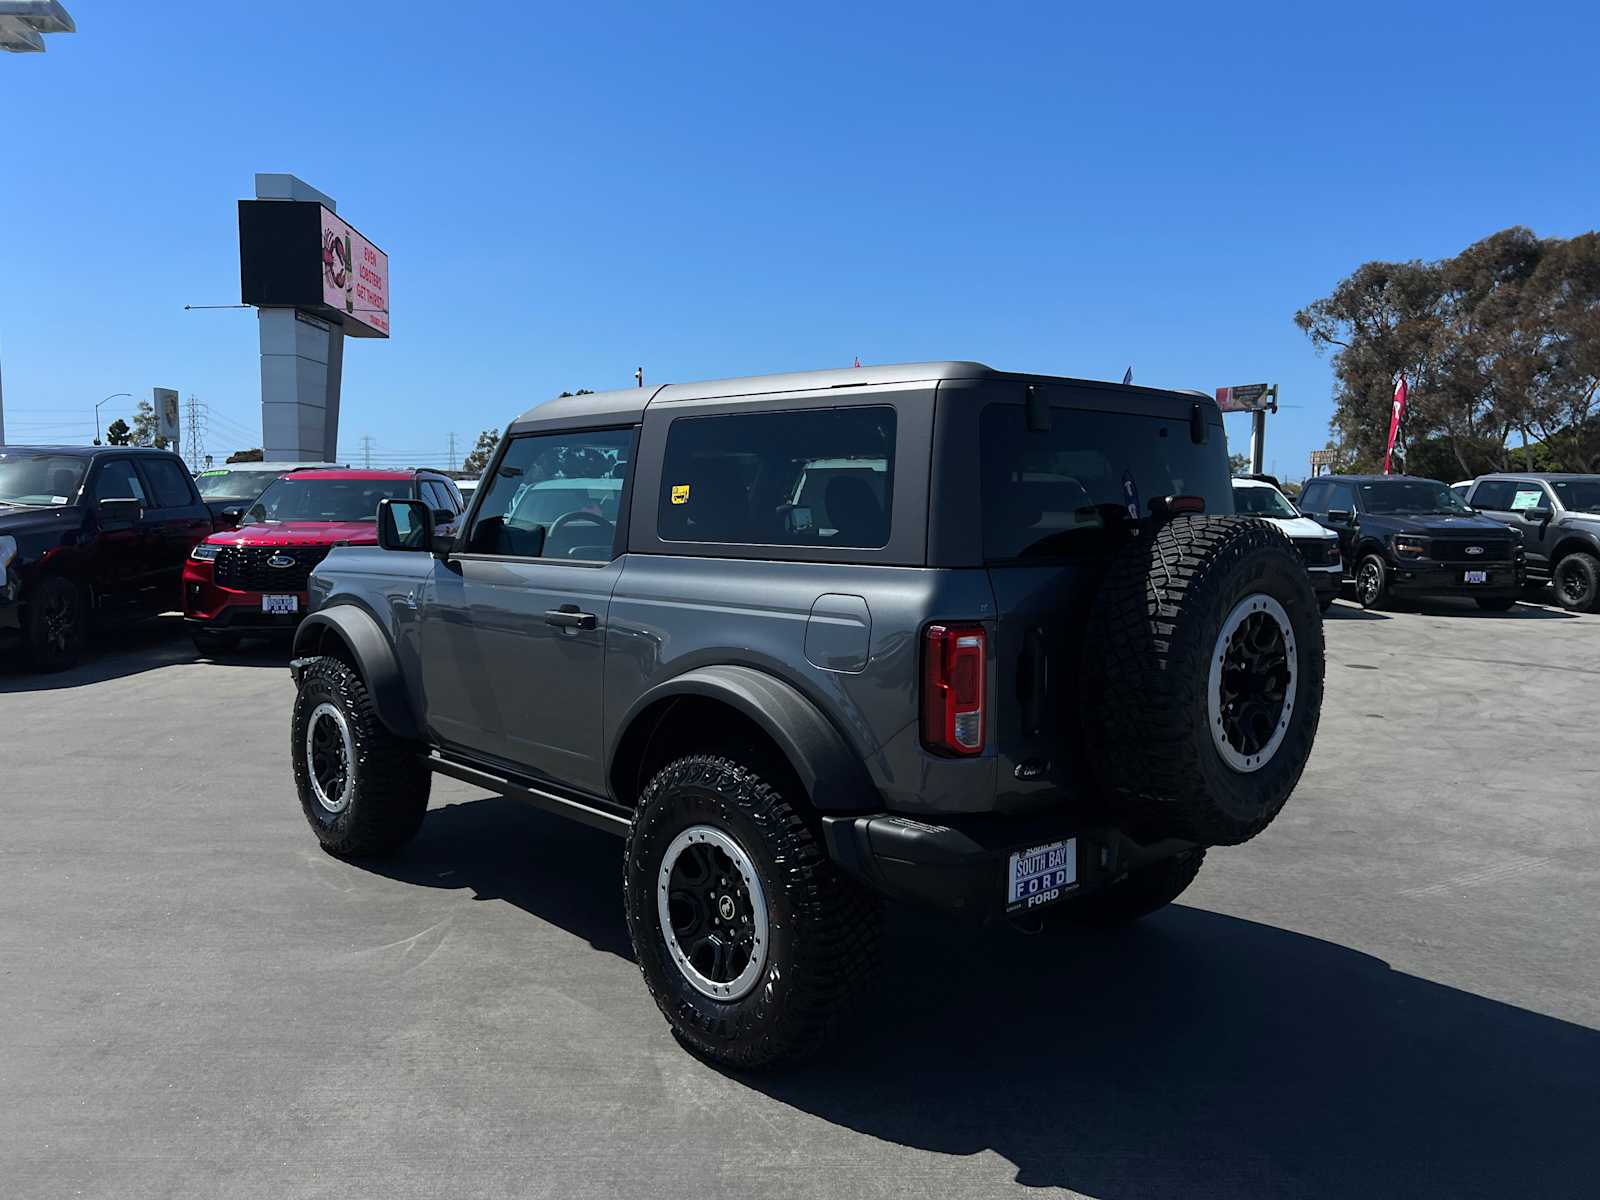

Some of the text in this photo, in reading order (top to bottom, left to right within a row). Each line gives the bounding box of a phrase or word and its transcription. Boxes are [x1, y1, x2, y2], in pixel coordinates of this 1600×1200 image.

[364, 247, 377, 266] EVEN
[360, 264, 382, 289] LOBSTERS
[356, 283, 366, 299] GET
[1017, 855, 1046, 877] SOUTH
[1048, 848, 1066, 867] BAY
[1028, 888, 1060, 908] FORD
